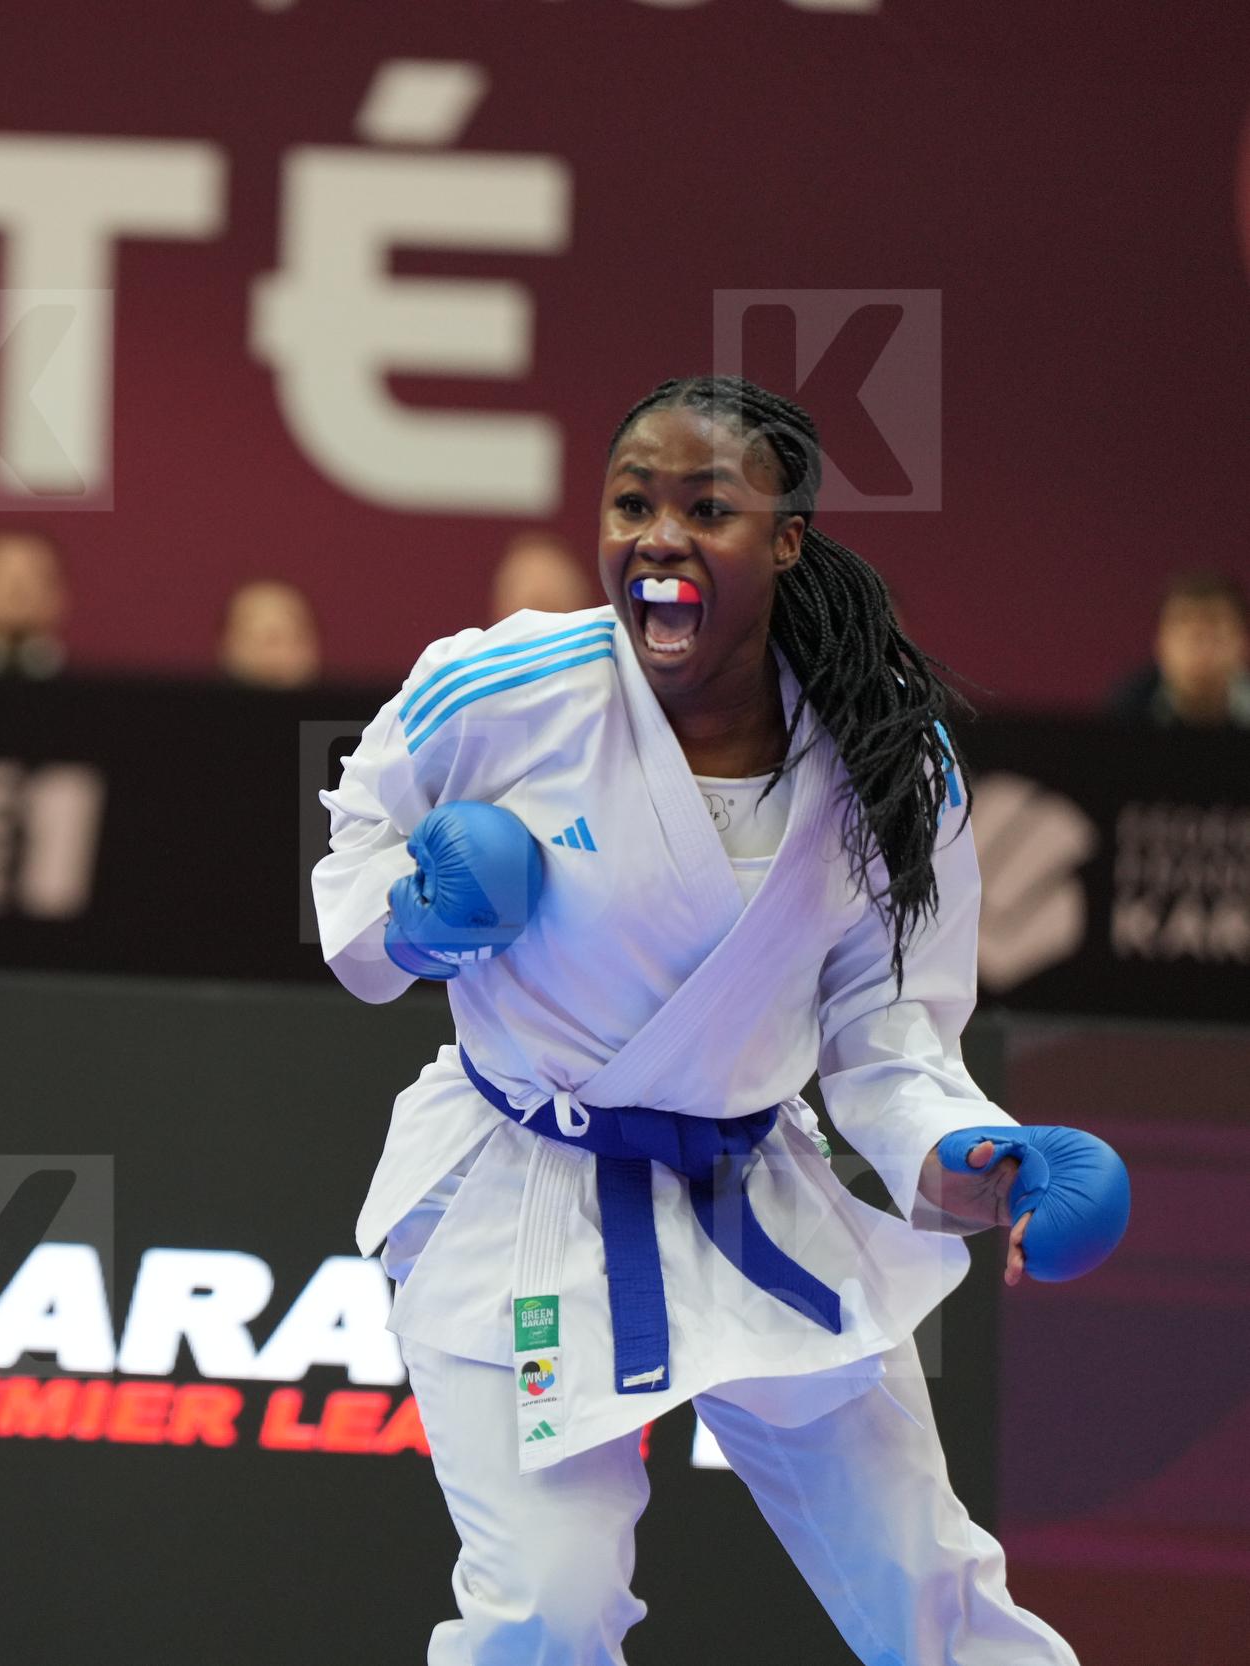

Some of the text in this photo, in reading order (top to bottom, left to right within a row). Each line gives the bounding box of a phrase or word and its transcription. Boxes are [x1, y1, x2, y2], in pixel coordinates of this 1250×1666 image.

[521, 1308, 554, 1321] GREEN
[521, 1317, 554, 1328] KARATE
[523, 1370, 550, 1384] WKF
[521, 1396, 558, 1408] APPROVED
